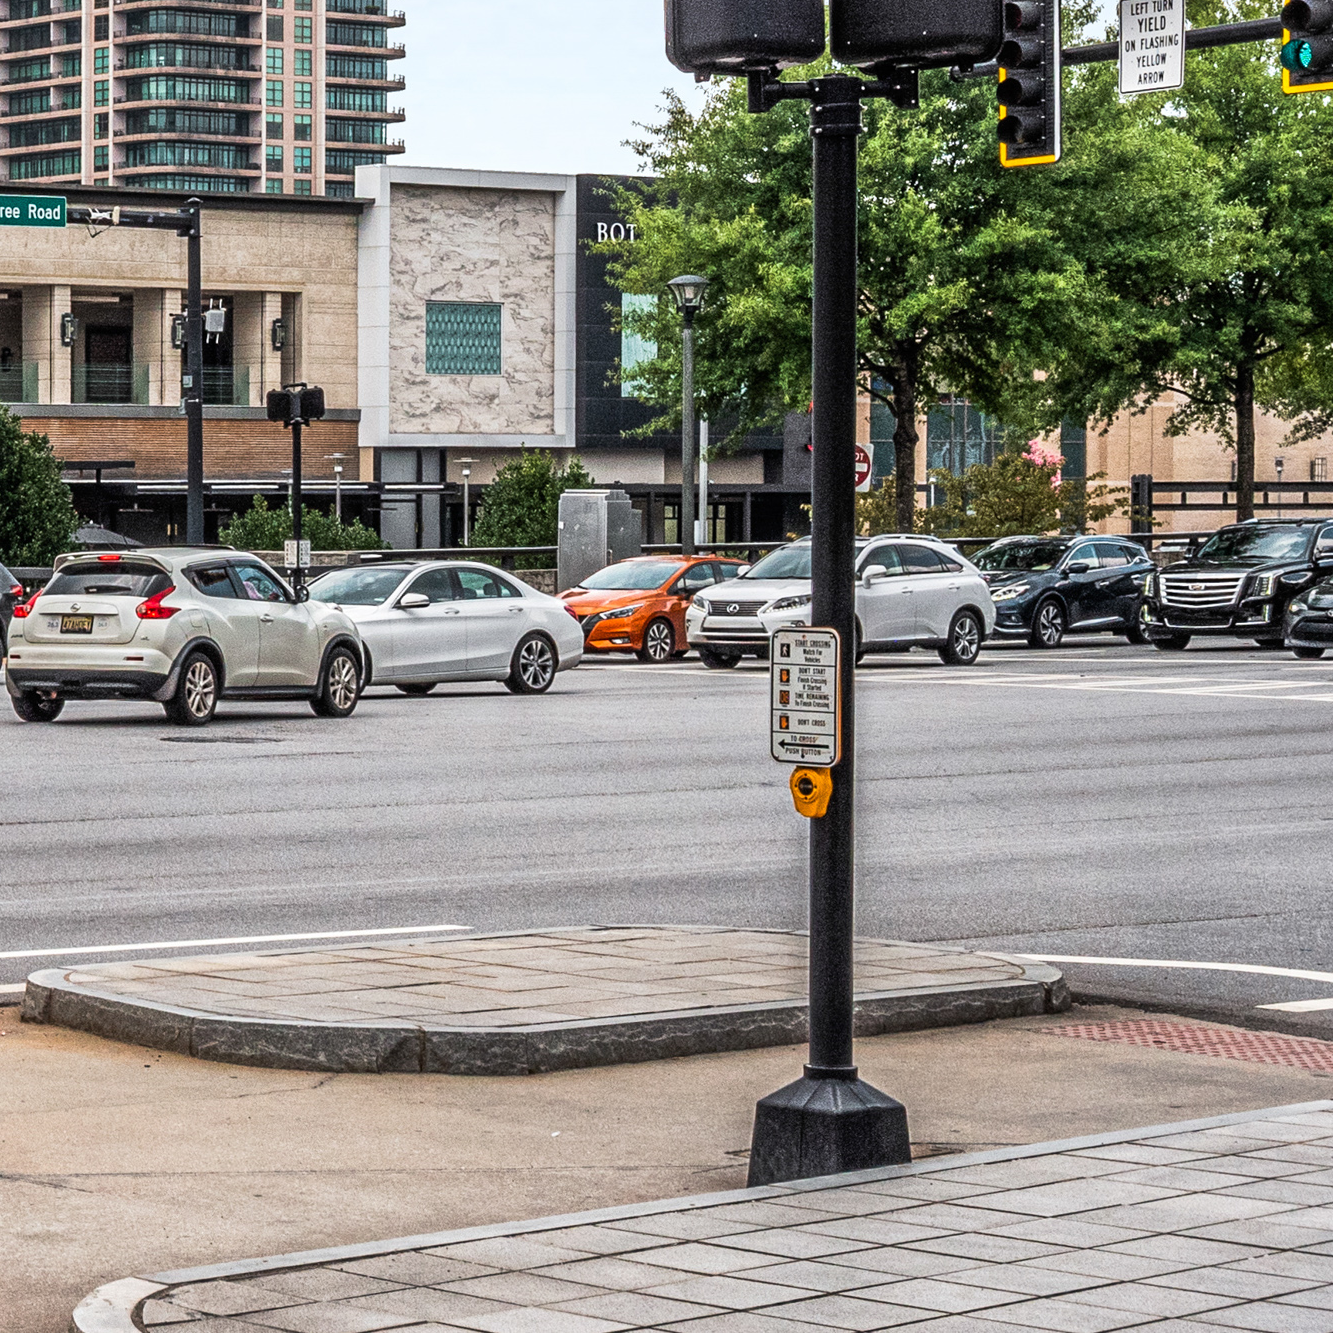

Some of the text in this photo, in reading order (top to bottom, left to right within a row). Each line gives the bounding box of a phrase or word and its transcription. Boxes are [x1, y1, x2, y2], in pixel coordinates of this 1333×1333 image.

[1130, 0, 1174, 16] LEFT TURN
[1137, 16, 1166, 33] YIELD
[1125, 34, 1179, 52] ON FLASHING
[1136, 53, 1167, 68] YELLOW
[1137, 71, 1165, 85] ARROW
[28, 205, 61, 220] Road
[809, 640, 831, 648] CROSSING
[785, 747, 800, 755] PUSH
[801, 748, 822, 756] BUTTON
